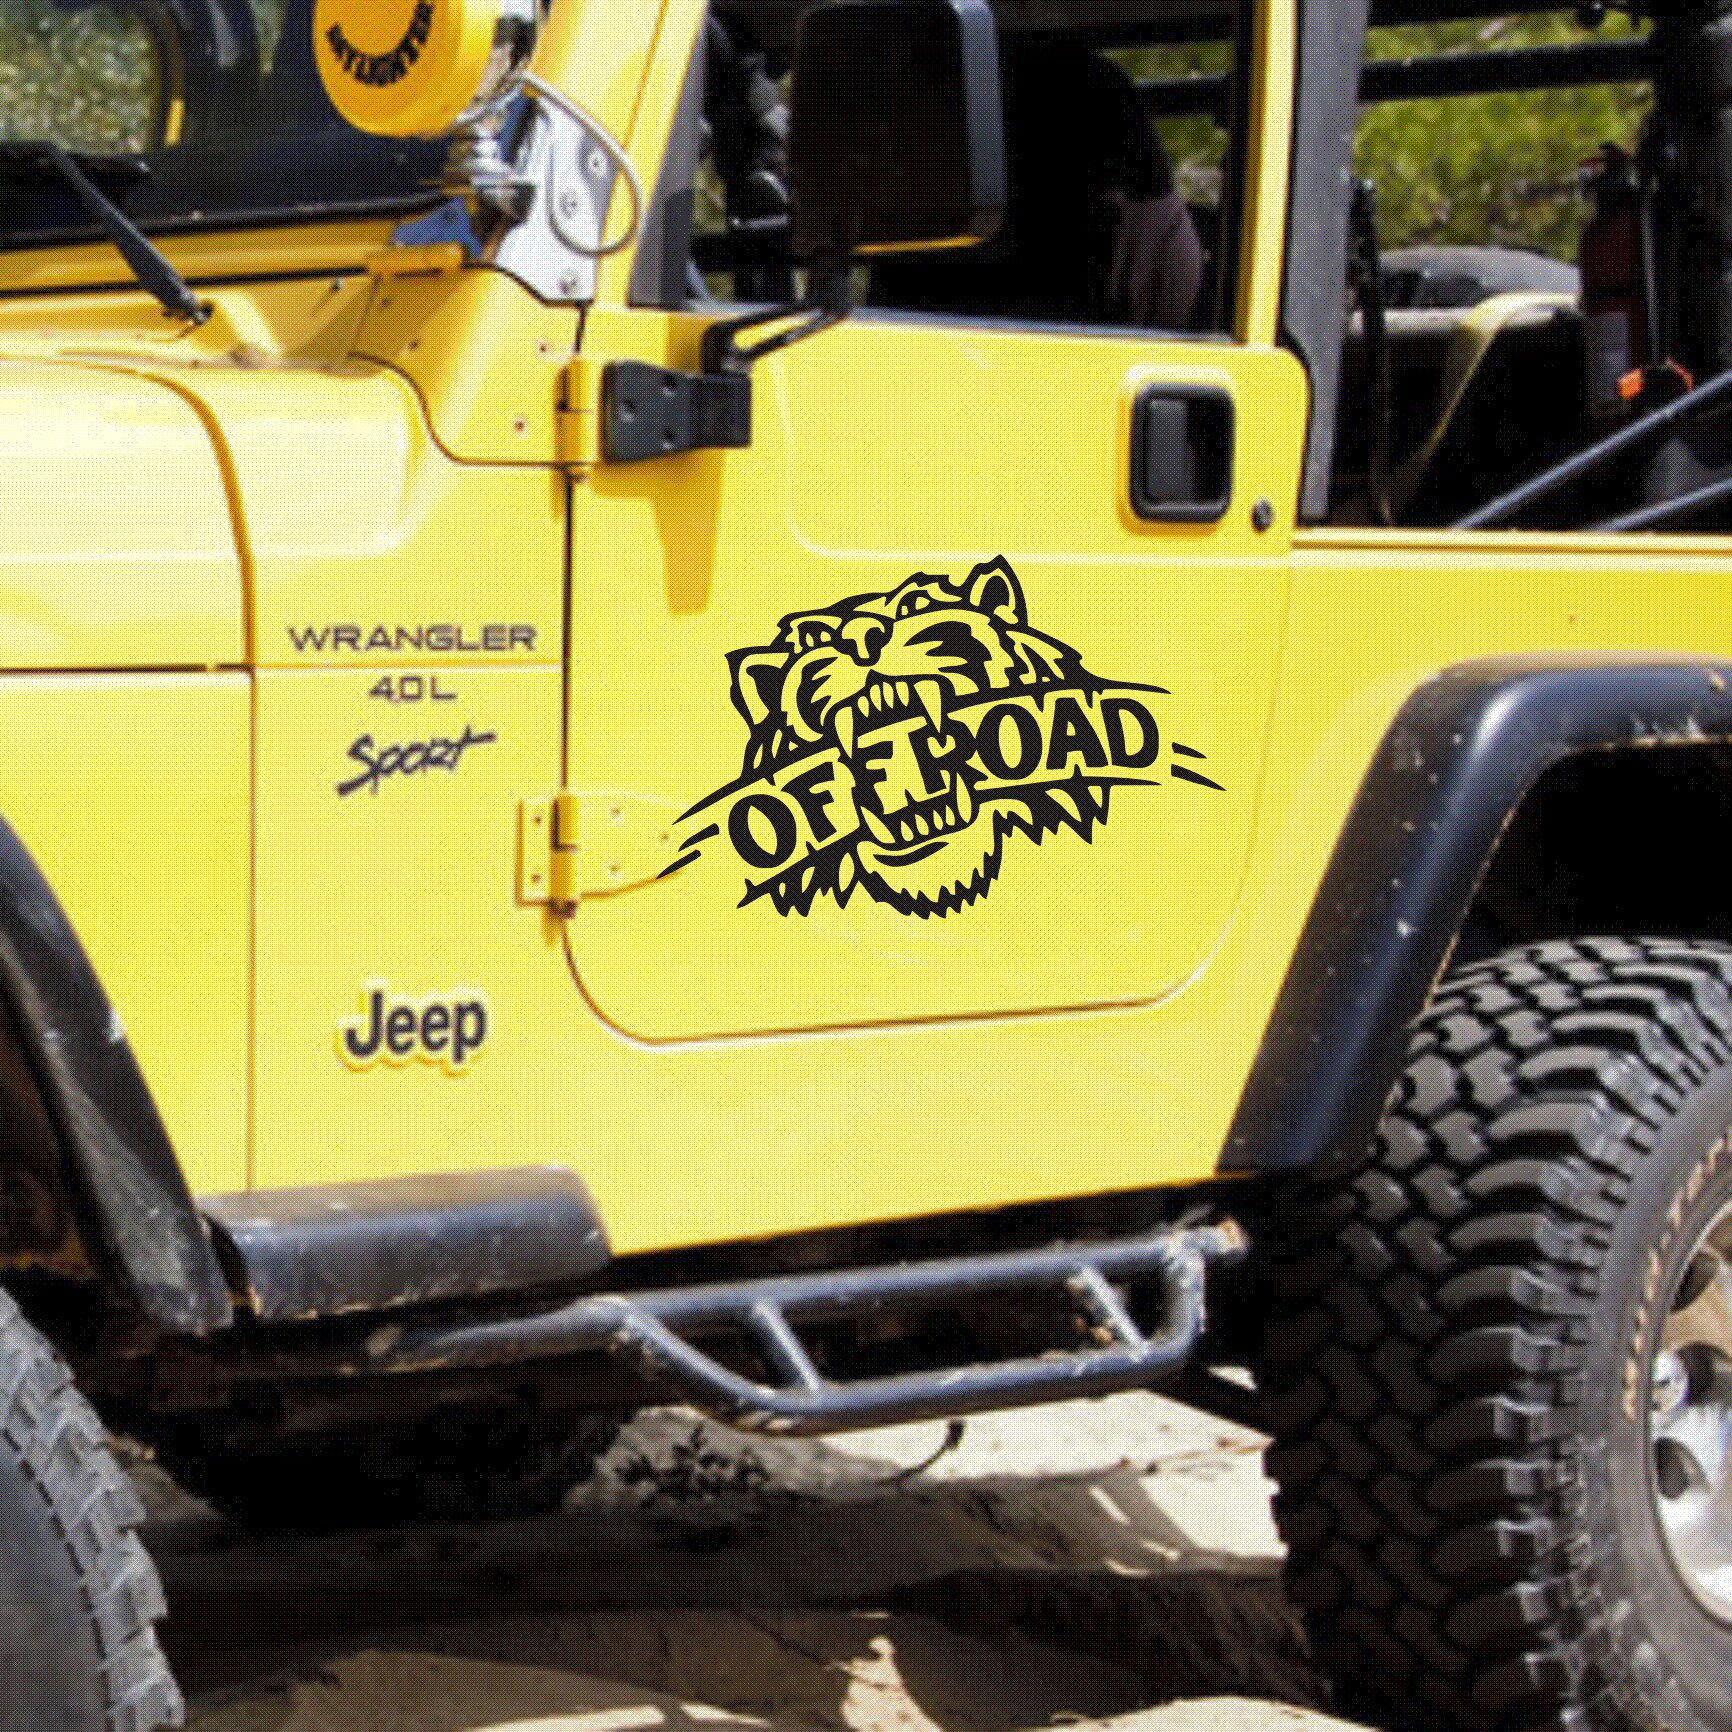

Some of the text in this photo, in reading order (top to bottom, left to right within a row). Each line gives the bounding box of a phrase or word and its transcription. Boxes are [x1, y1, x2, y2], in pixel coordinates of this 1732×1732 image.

[287, 624, 538, 651] WRANGLER
[908, 695, 1160, 796] ROAD
[345, 989, 487, 1064] Jeep
